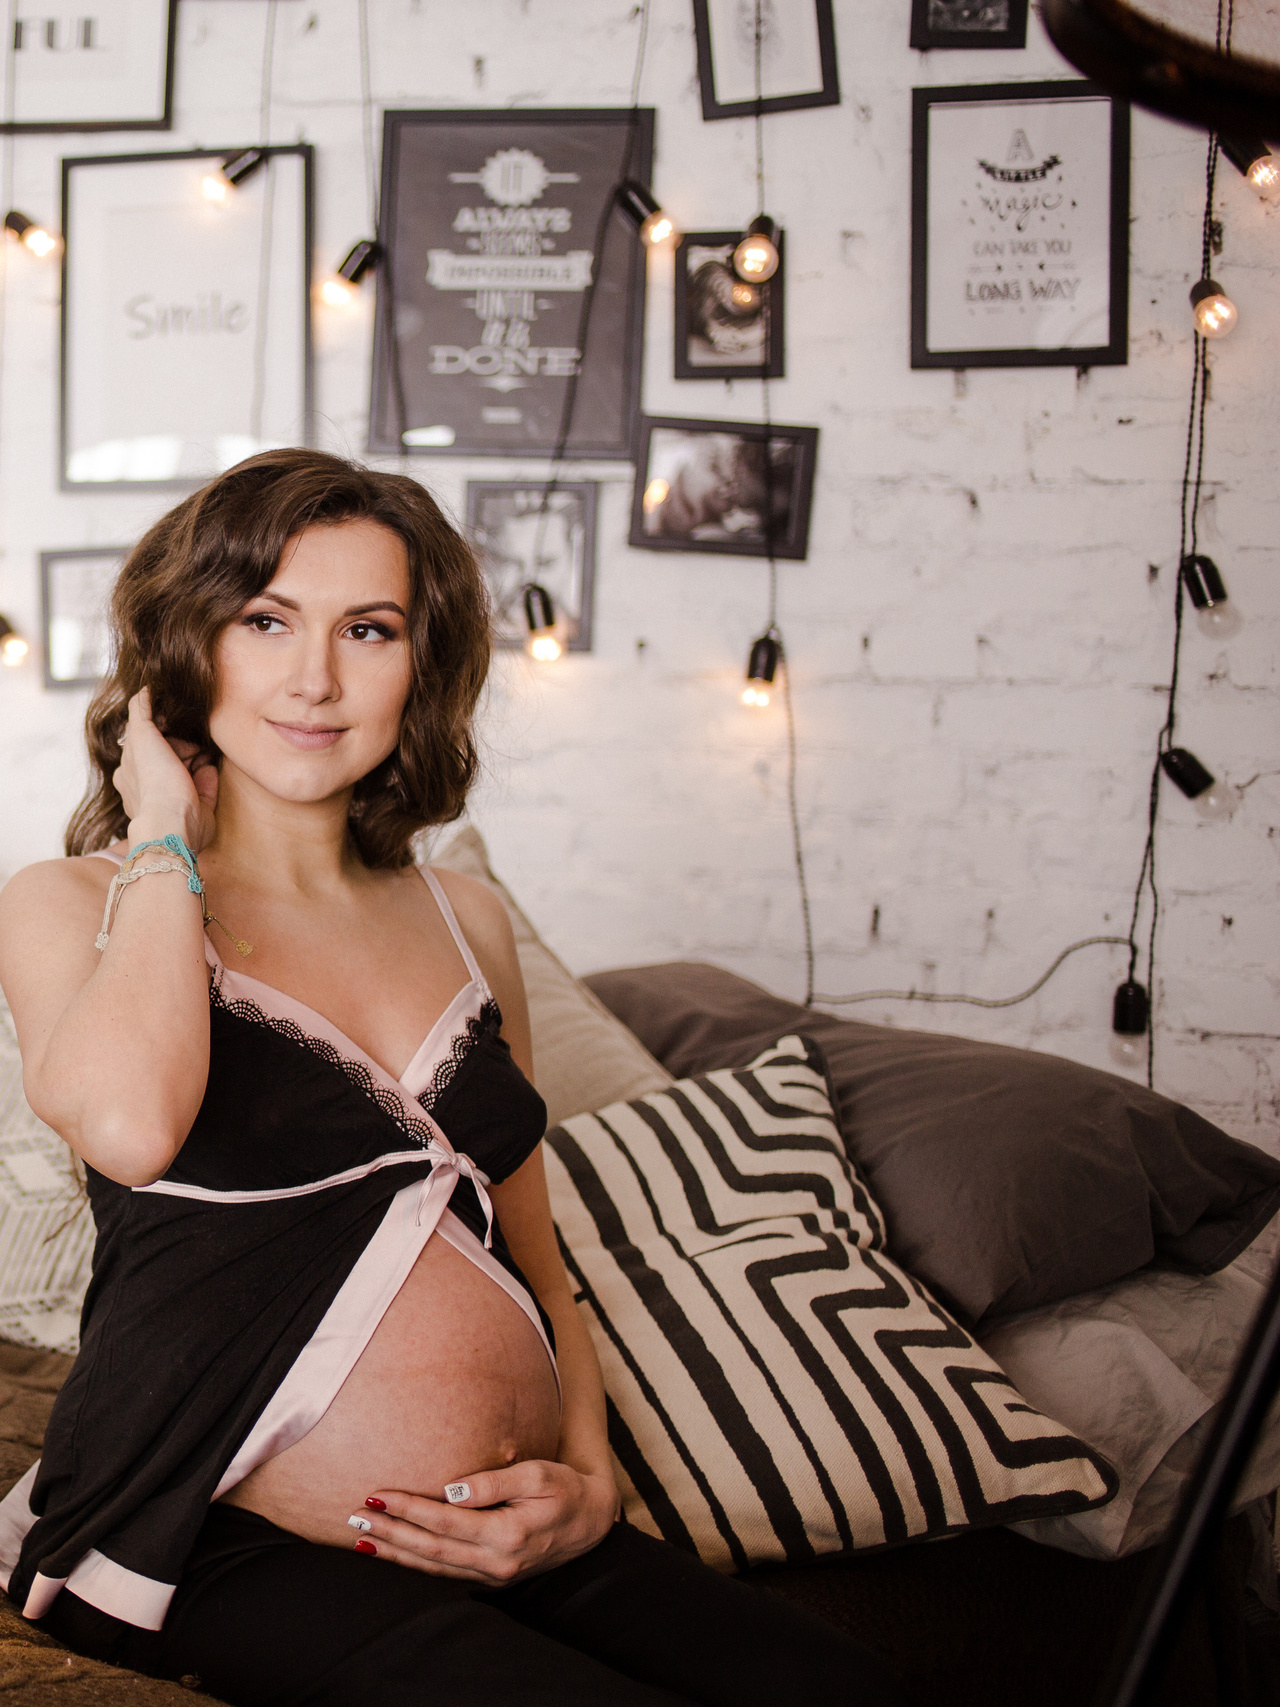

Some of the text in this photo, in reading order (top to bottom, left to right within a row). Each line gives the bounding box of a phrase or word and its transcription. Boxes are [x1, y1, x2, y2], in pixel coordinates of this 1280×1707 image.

[453, 207, 573, 233] ALWAYS
[1043, 239, 1072, 255] YOU
[966, 277, 1081, 303] LONG WAY
[124, 290, 250, 340] Smile
[428, 345, 582, 377] DONE
